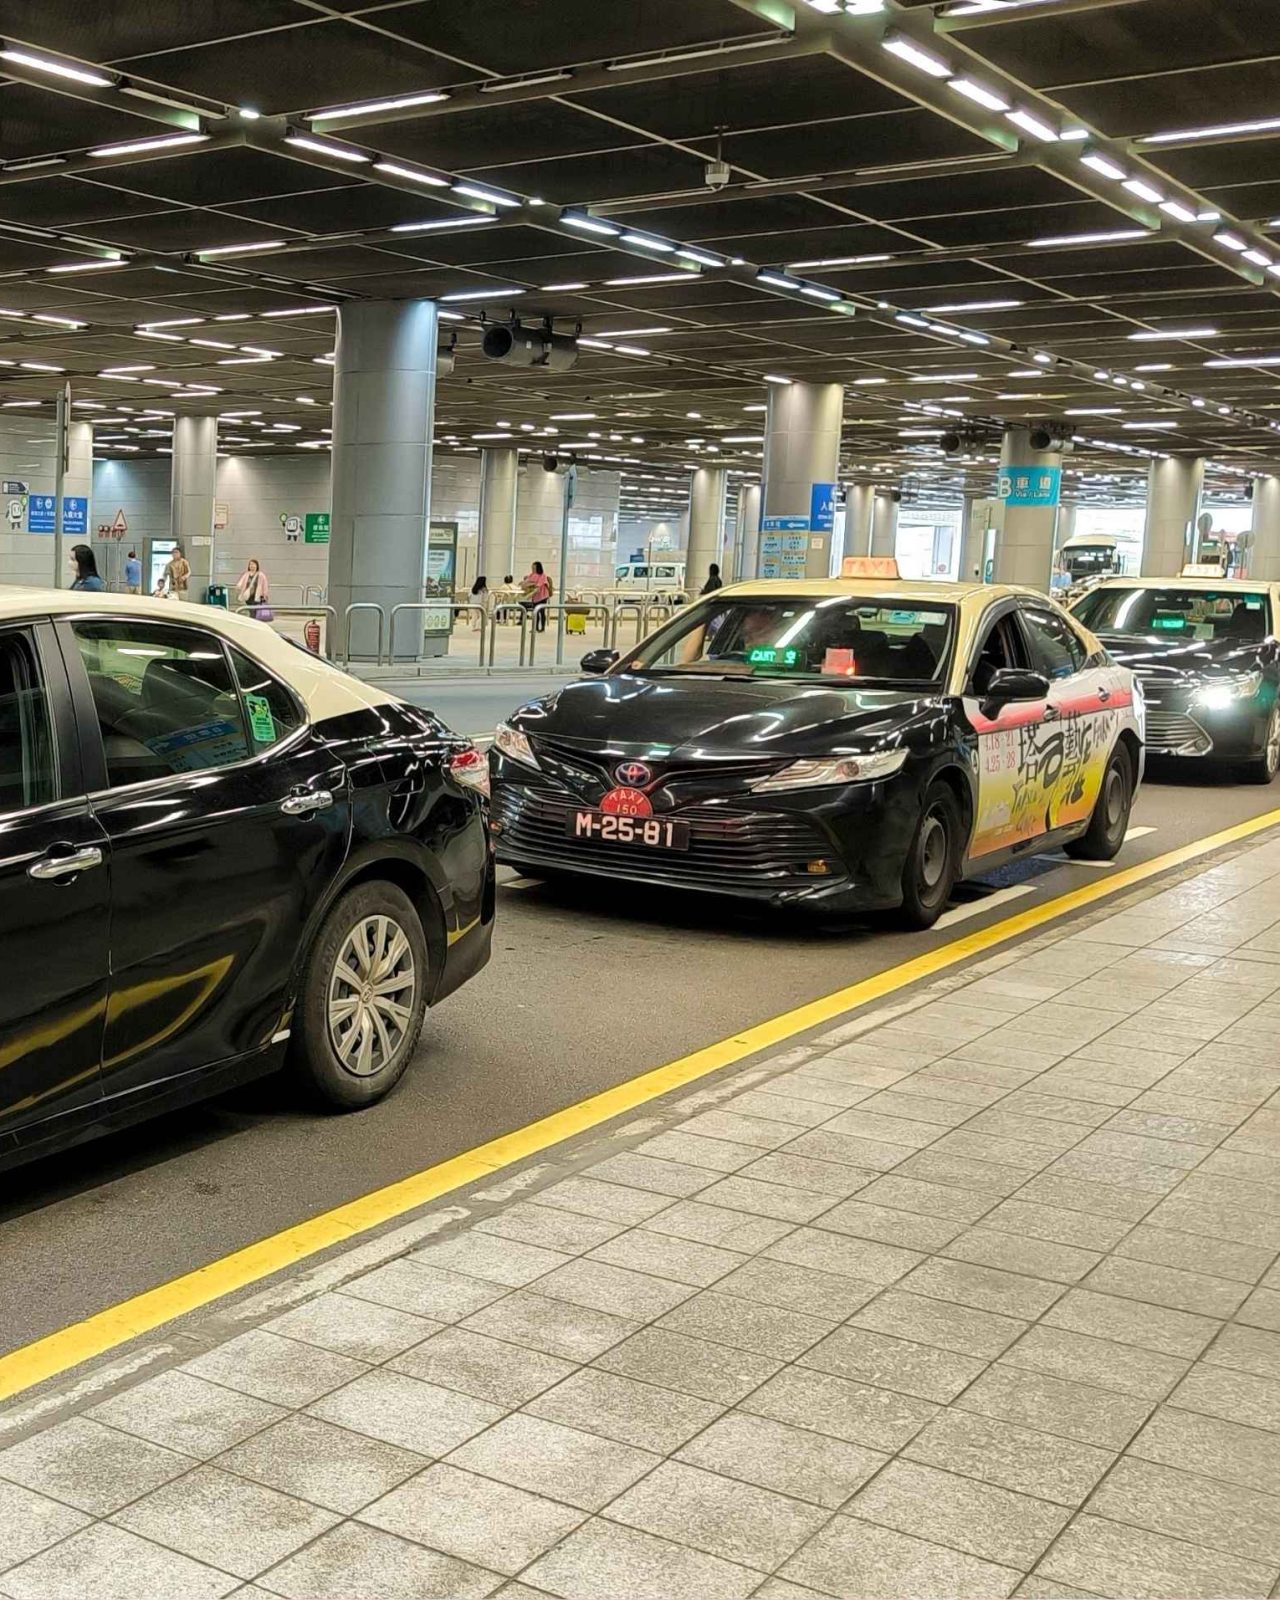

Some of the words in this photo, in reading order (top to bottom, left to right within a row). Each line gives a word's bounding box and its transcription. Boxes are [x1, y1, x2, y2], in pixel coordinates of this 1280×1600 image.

[998, 476, 1012, 498] B
[845, 560, 892, 575] TAXI
[609, 789, 645, 805] TAXI
[616, 804, 638, 815] 150
[576, 812, 673, 847] M-25-81
